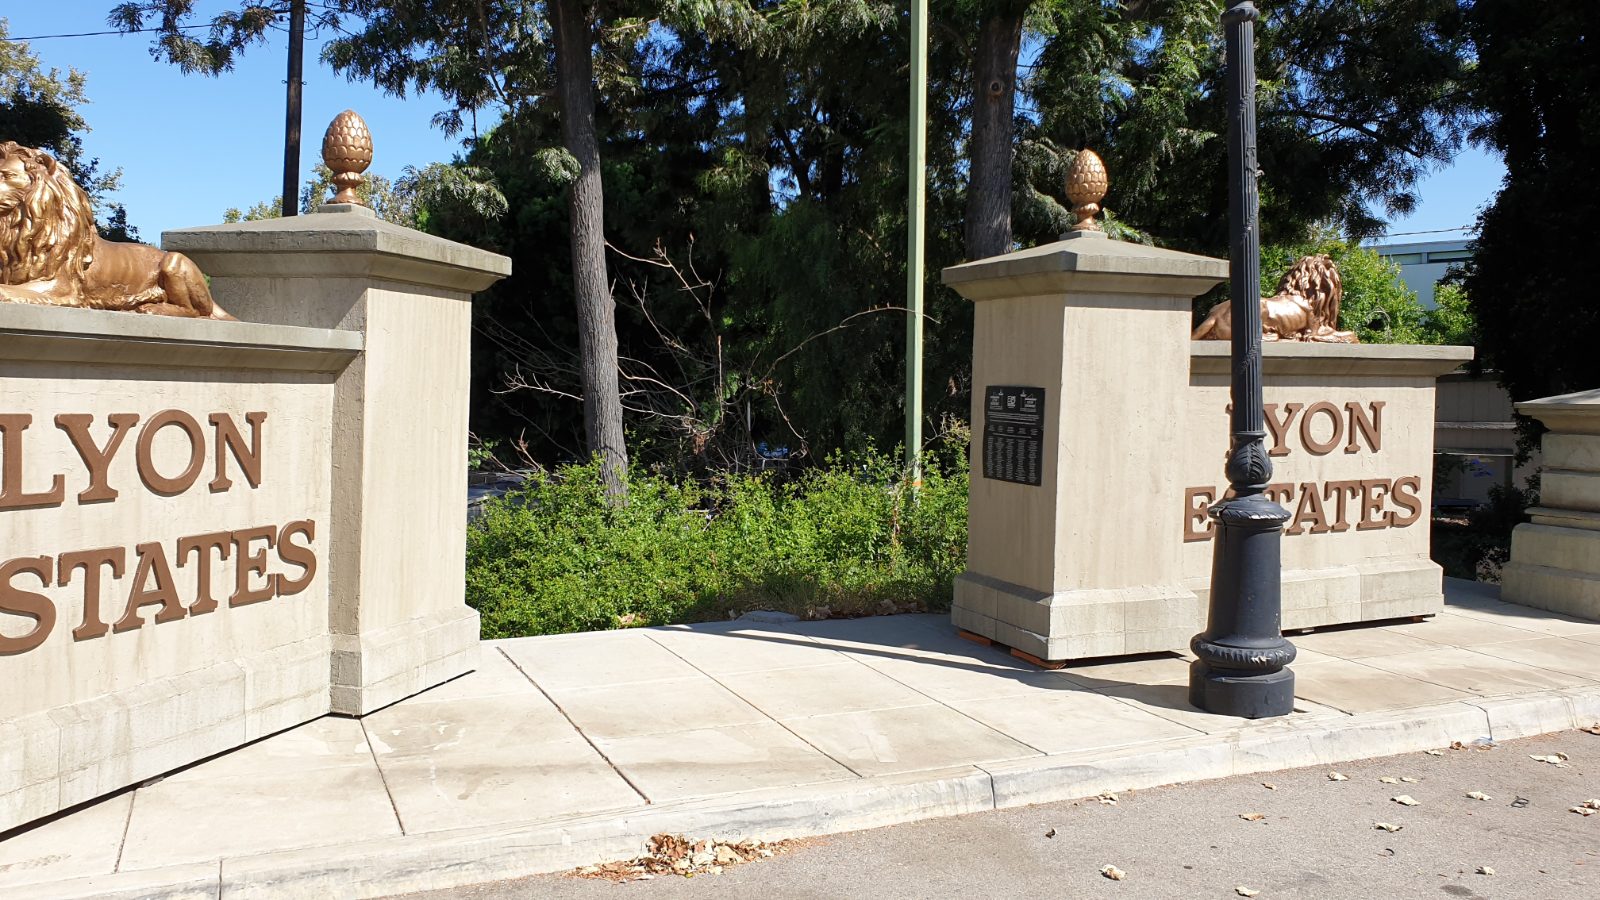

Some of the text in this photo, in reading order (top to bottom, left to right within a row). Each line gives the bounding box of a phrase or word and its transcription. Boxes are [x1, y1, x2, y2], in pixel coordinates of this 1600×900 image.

[0, 409, 267, 512] LYON
[1225, 401, 1386, 458] YON
[1184, 476, 1422, 543] ETATES
